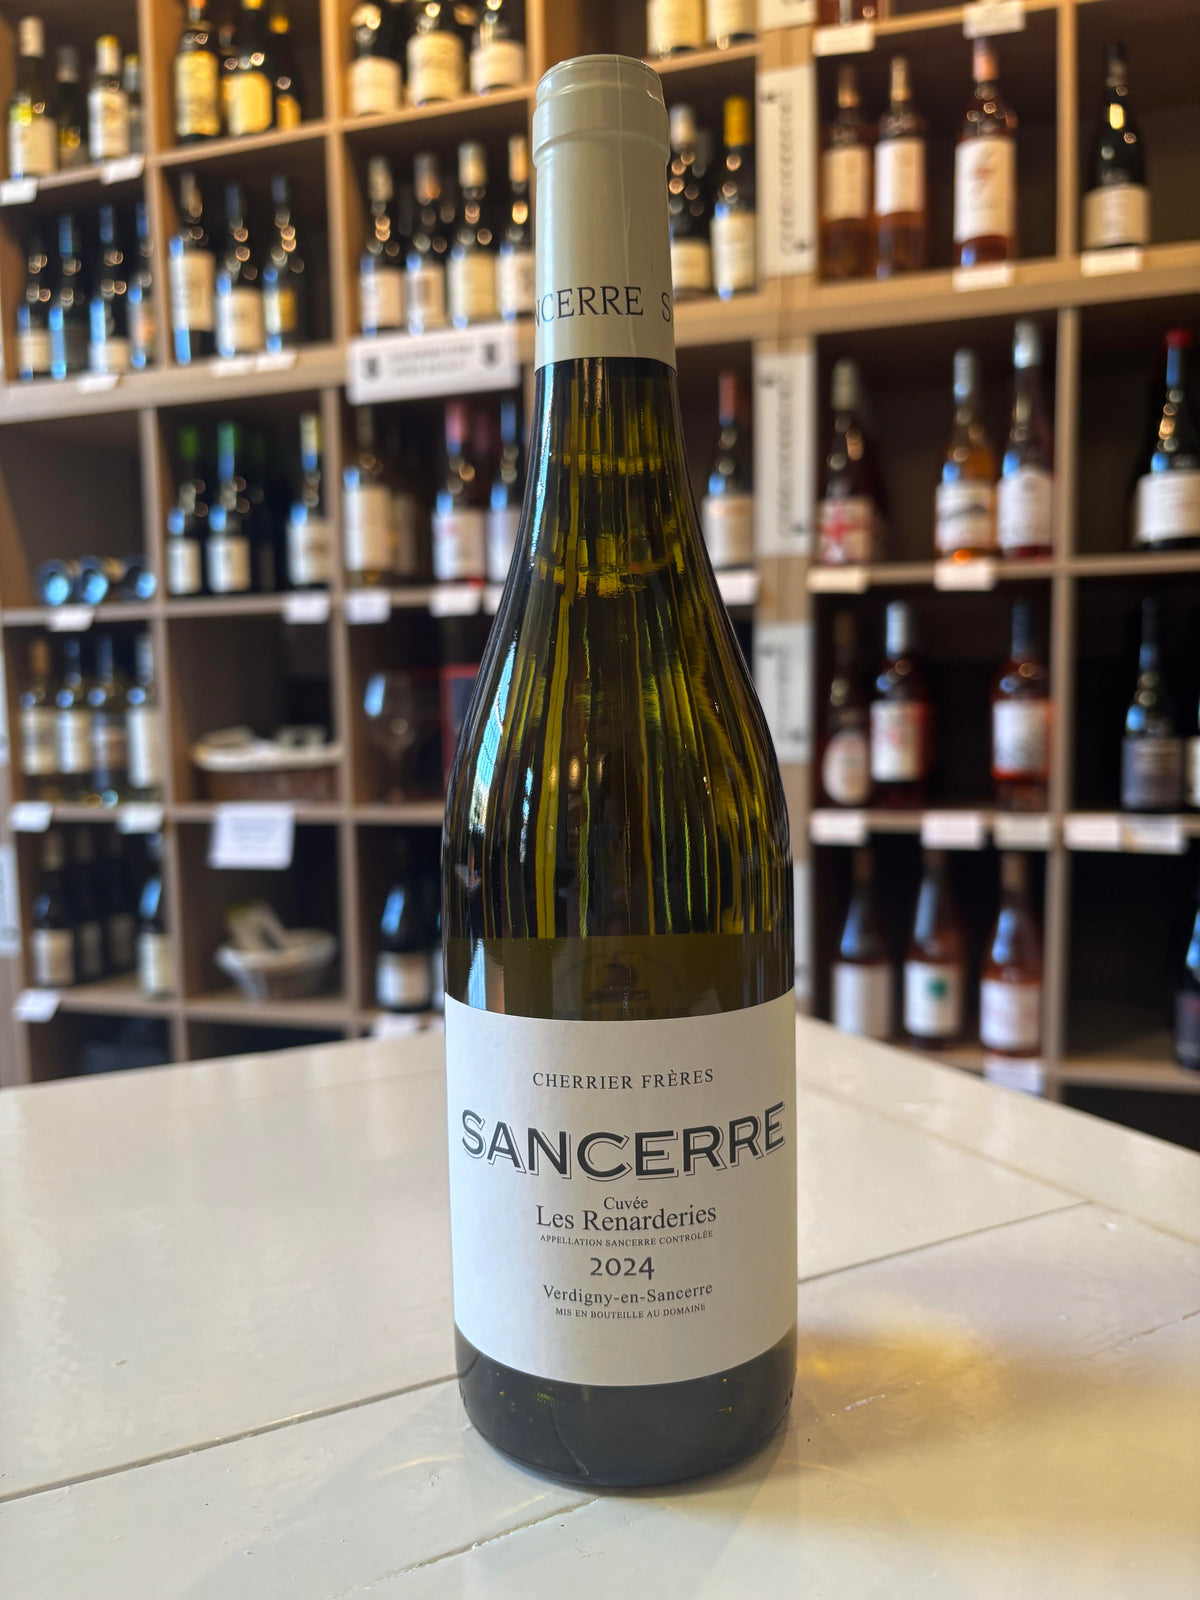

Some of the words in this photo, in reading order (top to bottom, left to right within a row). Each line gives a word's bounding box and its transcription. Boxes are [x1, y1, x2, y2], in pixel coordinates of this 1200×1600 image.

[661, 292, 673, 322] S
[533, 1072, 633, 1090] CHERRIER
[641, 1069, 714, 1089] FRÈRES
[461, 1101, 785, 1182] SANCERRE
[603, 1196, 649, 1210] Cuvée
[536, 1204, 574, 1230] Les
[582, 1205, 717, 1231] Renarderies
[540, 1234, 602, 1246] APPELLATION
[605, 1238, 656, 1247] SANCERRE
[590, 1256, 655, 1280] 2024
[543, 1283, 713, 1306] Verdigny-en-Sancerre
[555, 1307, 572, 1316] MIS
[575, 1309, 588, 1318] EN
[590, 1310, 644, 1319] BOUTEILLE
[646, 1310, 660, 1318] AU
[663, 1303, 706, 1317] DOMAINE
